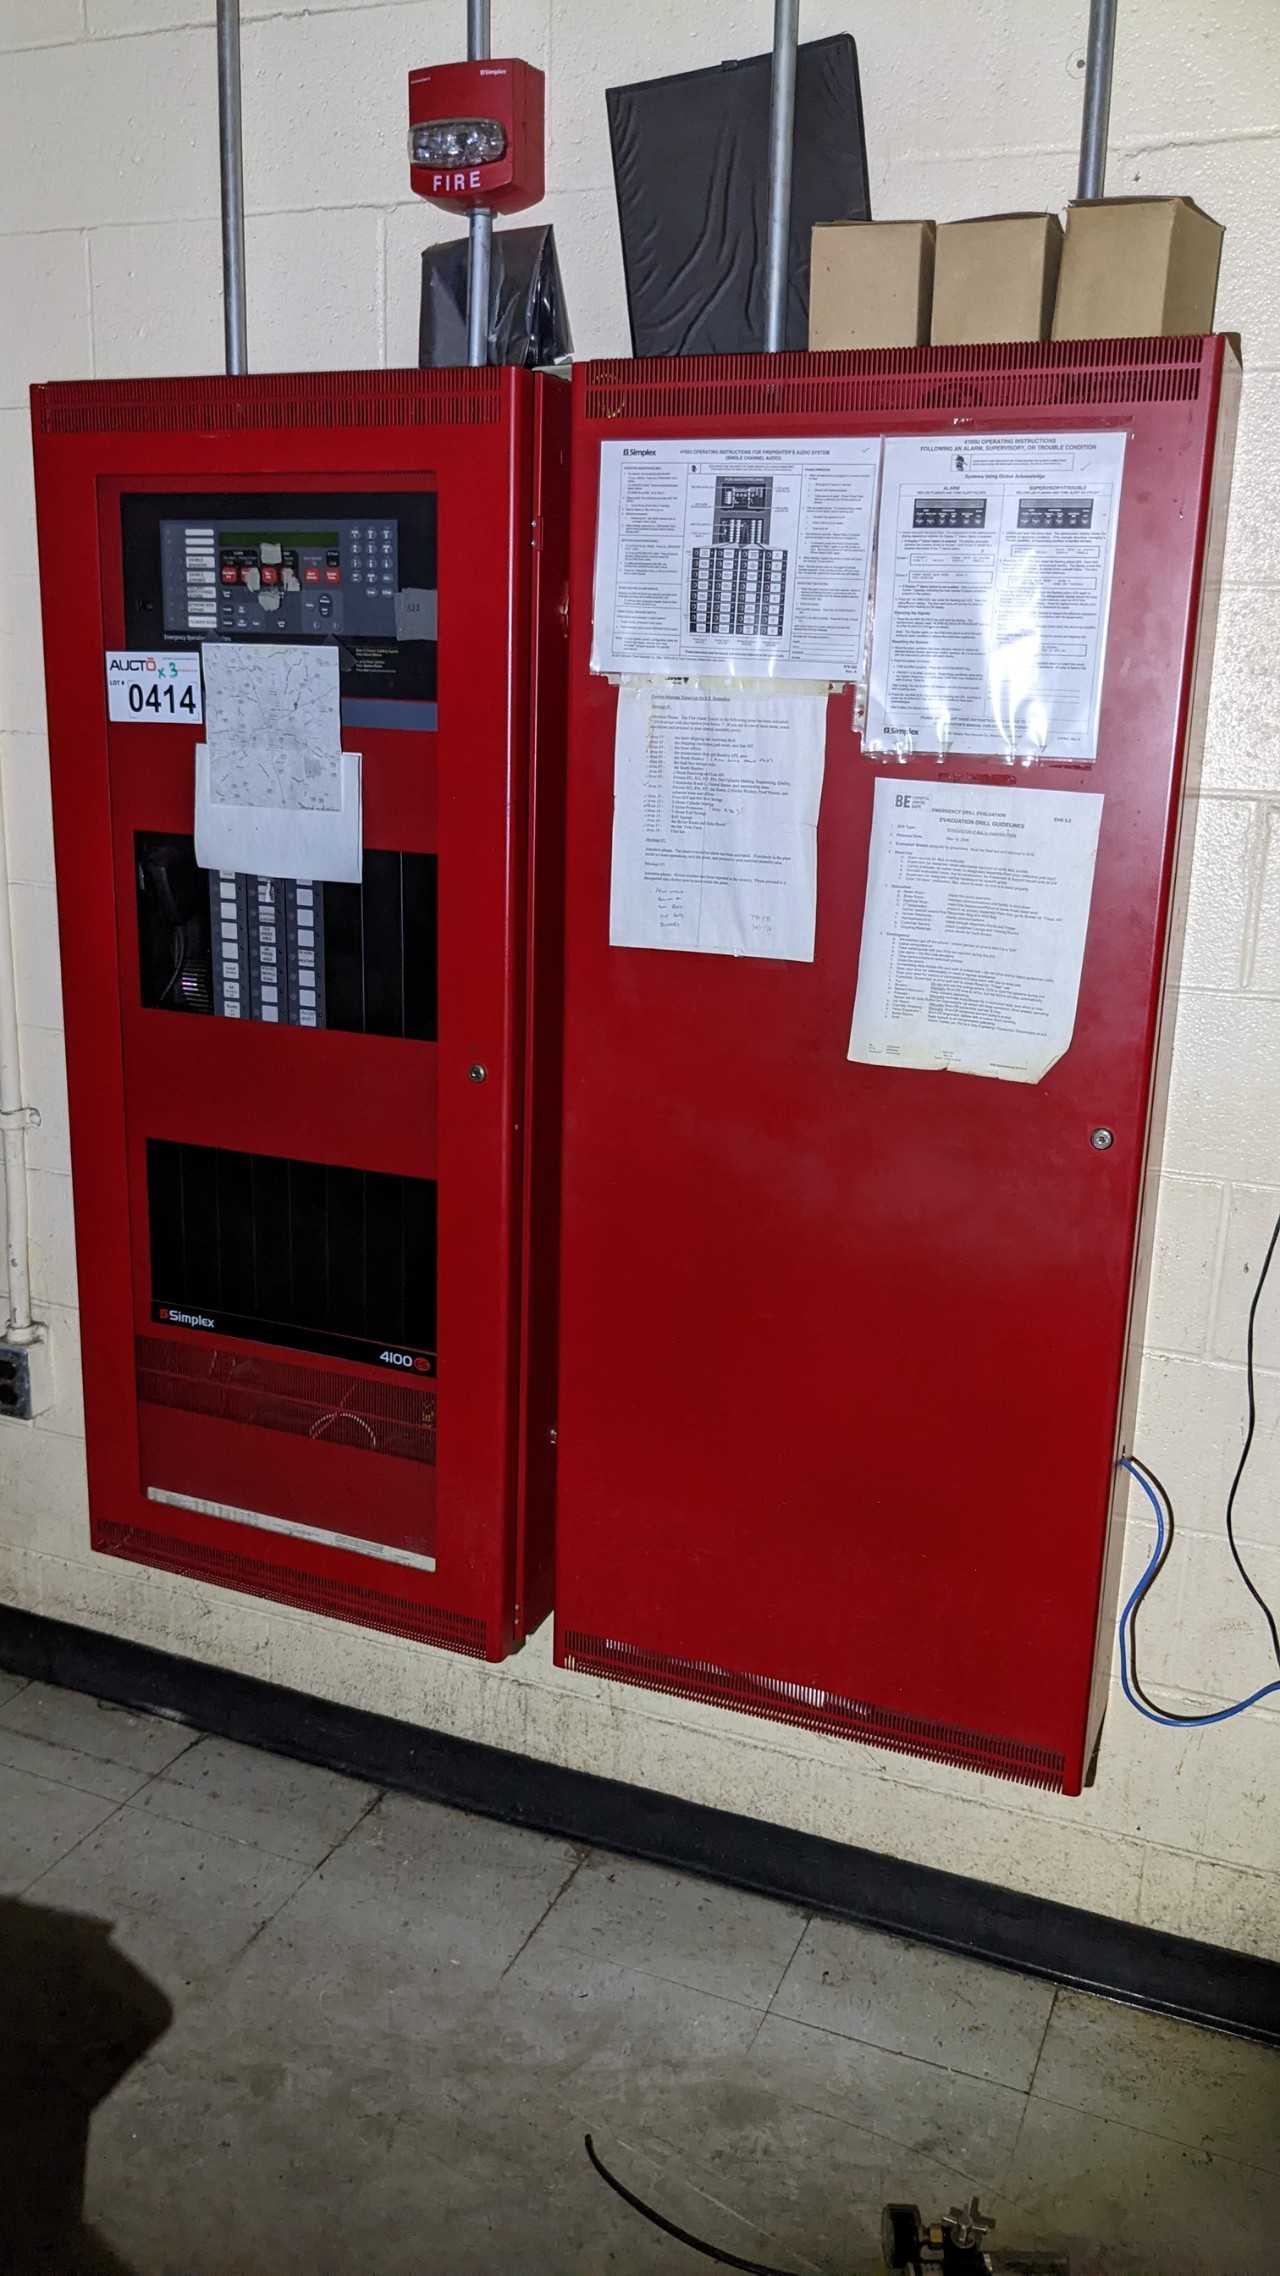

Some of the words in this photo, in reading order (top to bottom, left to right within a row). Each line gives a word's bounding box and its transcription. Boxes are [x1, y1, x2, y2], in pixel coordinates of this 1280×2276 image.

[433, 170, 481, 192] FIRE
[630, 448, 656, 459] Simplex
[129, 683, 196, 714] 0414
[895, 794, 911, 808] BE
[169, 1309, 215, 1329] Simplex
[379, 1351, 413, 1368] 4100
